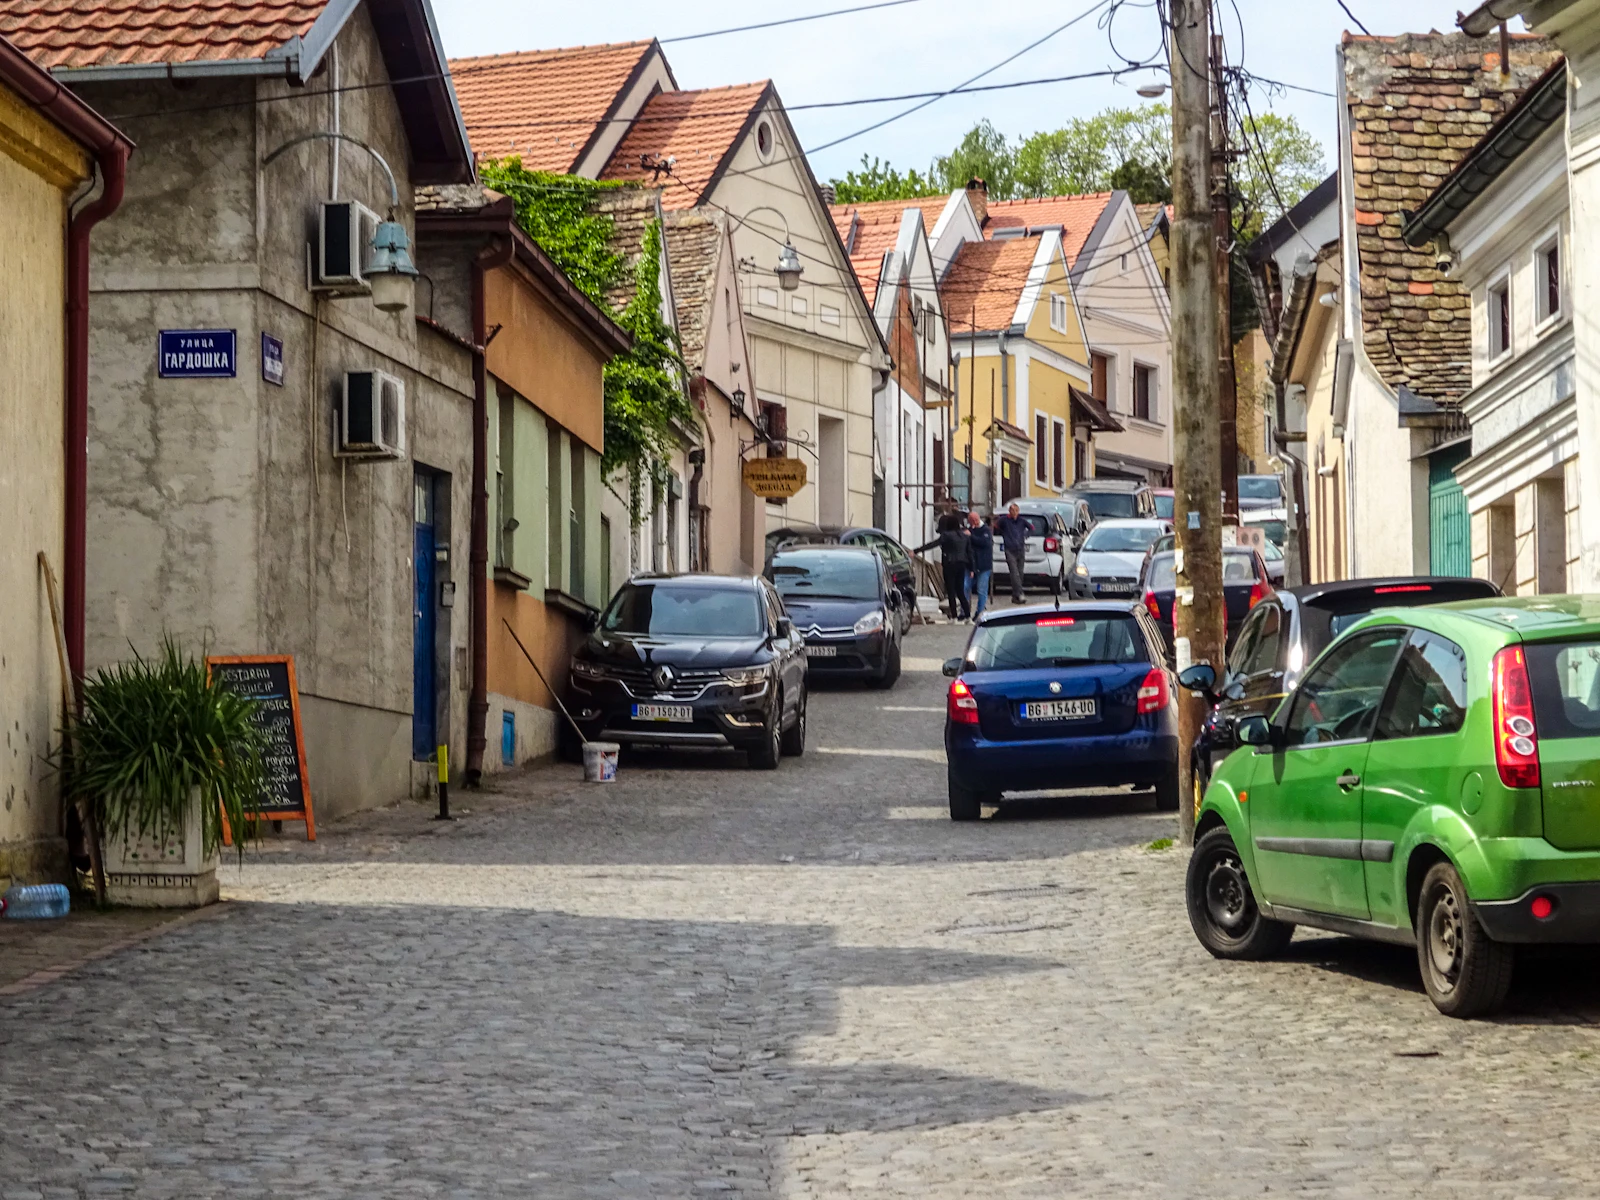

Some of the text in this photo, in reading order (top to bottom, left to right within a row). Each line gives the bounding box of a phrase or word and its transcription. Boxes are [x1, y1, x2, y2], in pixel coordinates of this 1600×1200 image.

[180, 338, 214, 348] УЛИЦА
[165, 352, 229, 369] ГАРДОШКА
[1028, 704, 1041, 716] BG
